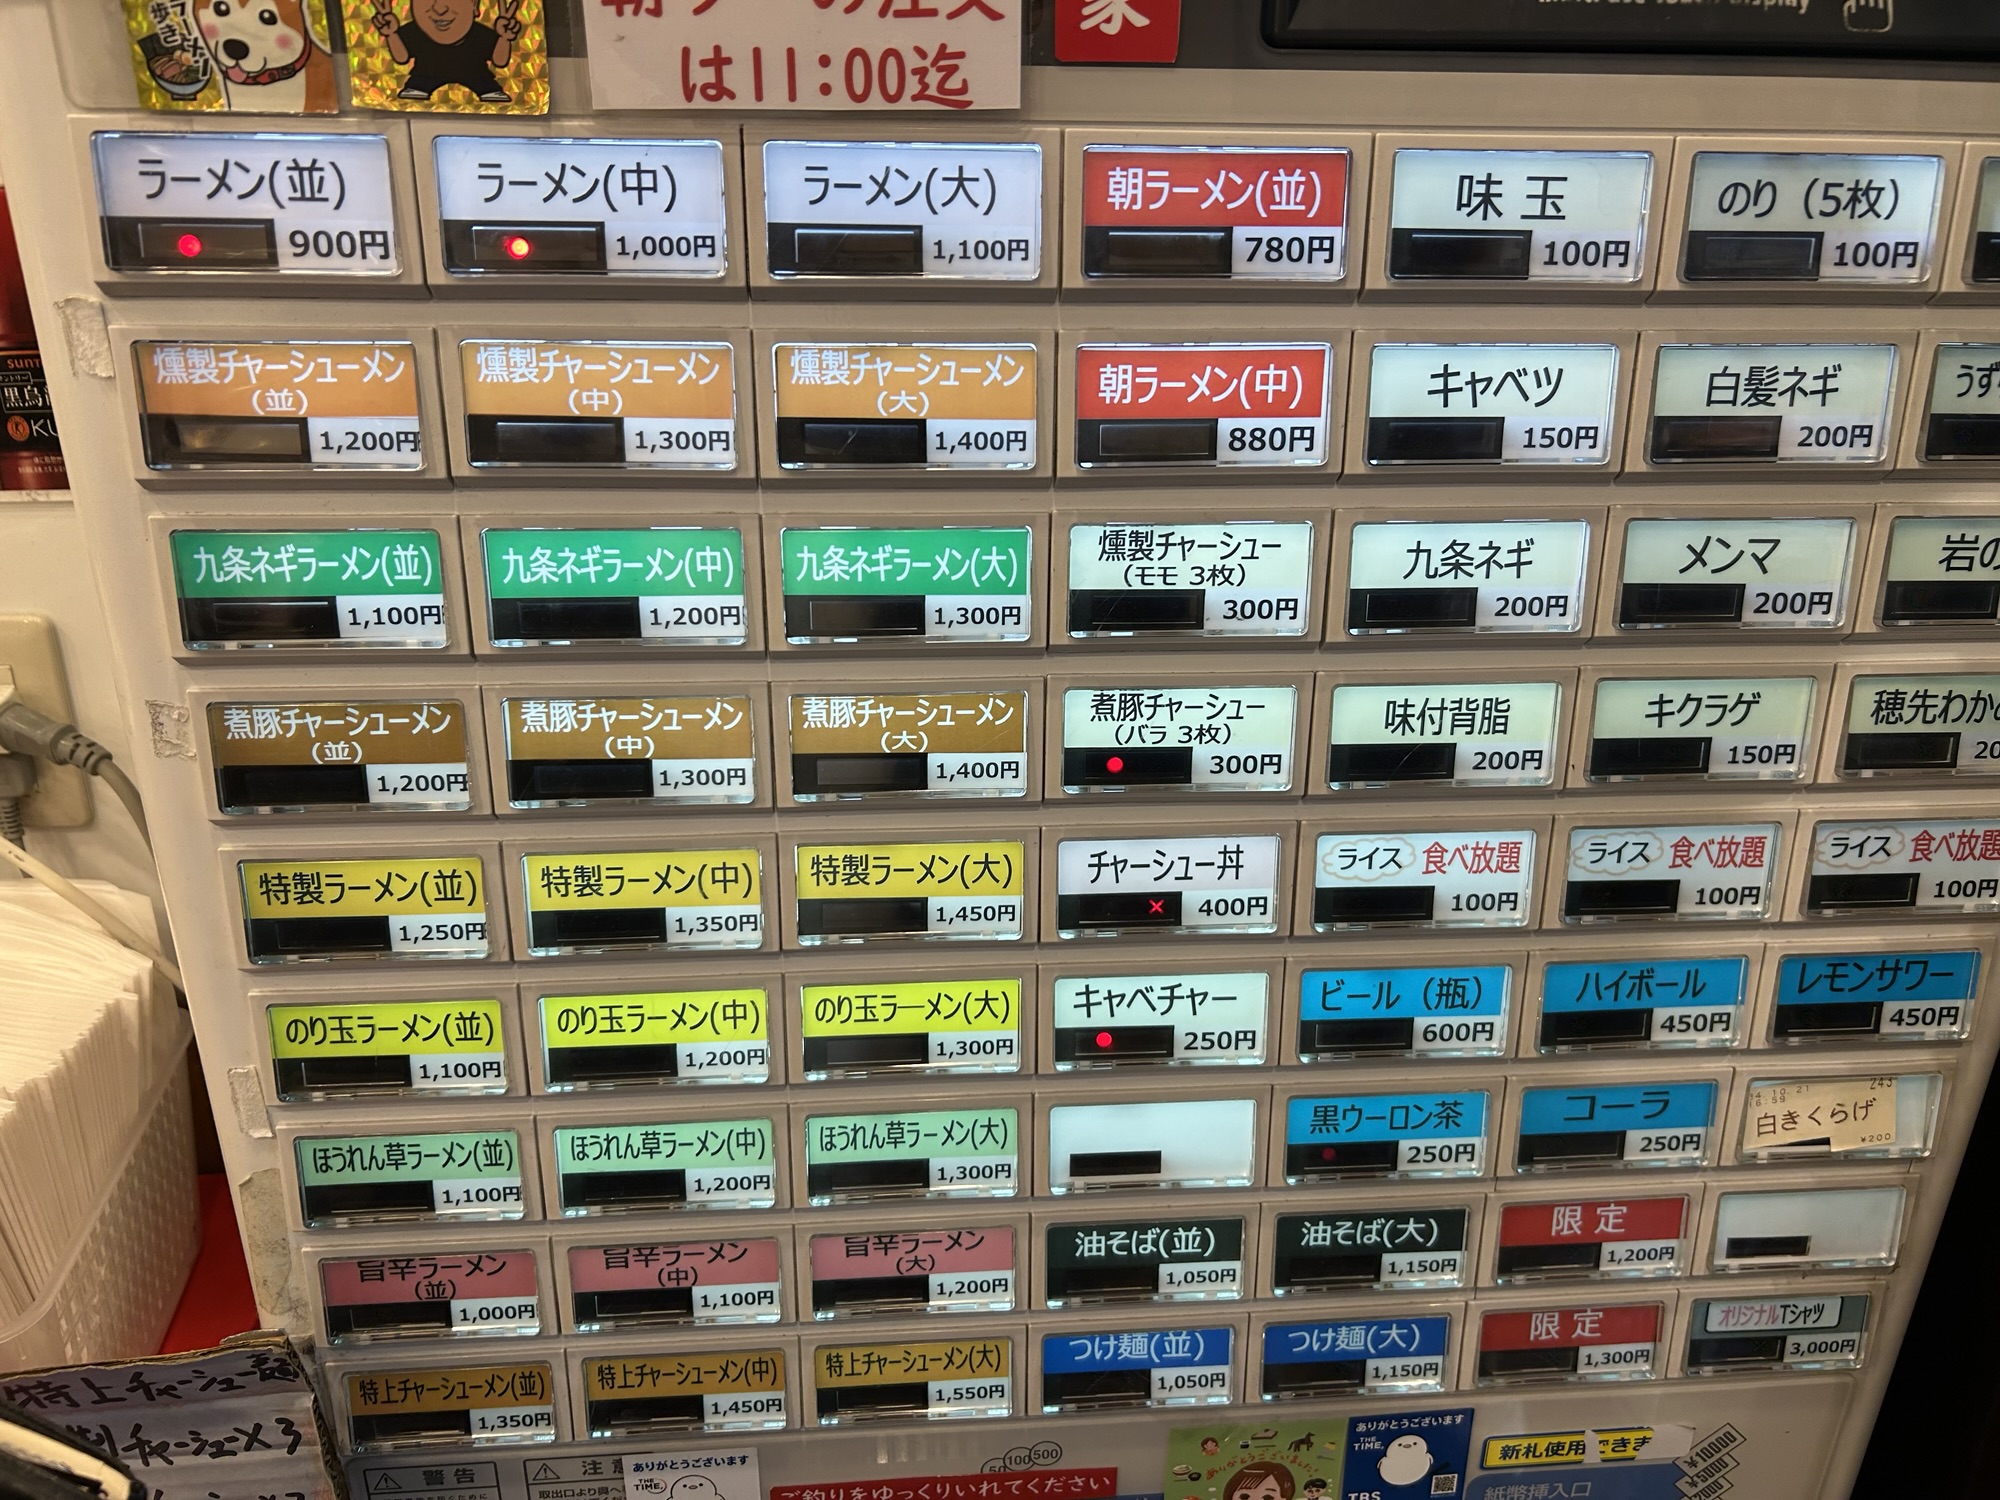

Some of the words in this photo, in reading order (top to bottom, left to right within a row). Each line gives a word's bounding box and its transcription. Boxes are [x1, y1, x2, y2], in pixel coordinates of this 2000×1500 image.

[680, 44, 973, 109] は11:00迄
[138, 158, 346, 209] ラーメン(並)
[478, 163, 677, 212] ラーメン(中)
[803, 165, 996, 214] ラーメン(大)
[1108, 167, 1322, 218] 朝ラーメン(並)
[289, 229, 390, 260] 900円
[616, 236, 716, 259] 1,000円
[933, 239, 1029, 262] 1,100円
[1245, 236, 1334, 263] 780円
[1543, 240, 1630, 268] 100円
[1833, 241, 1919, 268] 100円
[153, 346, 405, 385] 燻製チャーシューメン
[477, 345, 719, 385] 燻製チャーシューメン
[790, 347, 1024, 388] 燻製チャーシューメン
[1099, 363, 1302, 409] 朝ラーメン(中)
[1427, 363, 1564, 408] キャベツ
[1705, 364, 1843, 408] 白髪ネギ
[1957, 362, 2000, 398] うず
[252, 388, 308, 416] (並)
[569, 388, 622, 415] (中)
[877, 390, 929, 416] (大)
[320, 431, 420, 454] 1,200円
[634, 430, 730, 453] 1,300円
[934, 431, 1026, 453] 1,400円
[1228, 426, 1315, 452] 880円
[1522, 426, 1598, 450] 150円
[1798, 424, 1874, 449] 200円
[1098, 528, 1281, 563] 燻製チャーシュー
[1678, 535, 1781, 575] メンマ
[194, 544, 432, 587] 九条ネギラーメン(並)
[503, 544, 734, 587] 九条ネギラーメン(中)
[796, 545, 1017, 587] 九条ネギラーメン(大)
[1402, 538, 1534, 580] 九条ネギ
[1222, 598, 1299, 622] 300円
[1494, 595, 1568, 618] 200円
[1753, 591, 1833, 615] 200円
[348, 606, 442, 627] 1,100円
[650, 606, 740, 627] 1,200円
[934, 606, 1021, 627] 1,300円
[521, 700, 743, 734] 煮豚チャーシューメン
[802, 696, 1014, 730] 煮豚チャーシューメン
[1090, 692, 1265, 723] 煮豚チャーシュー
[1384, 697, 1511, 737] 味付背脂
[1644, 691, 1761, 729] キクラゲ
[1870, 688, 2000, 726] 穂先わか
[223, 703, 451, 740] 煮豚チャーシューメン
[311, 740, 362, 764] (並)
[605, 735, 654, 759] (中)
[881, 731, 928, 753] (大)
[1727, 743, 1796, 766] 150円
[936, 760, 1019, 782] 1,400円
[1209, 754, 1282, 777] 300円
[1472, 749, 1543, 772] 200円
[377, 773, 467, 795] 1,200円
[659, 768, 746, 788] 1,300円
[1337, 846, 1403, 873] ライス
[1422, 840, 1523, 876] 食べ放題
[1588, 840, 1651, 866] ライス
[1669, 834, 1767, 870] 食べ放題
[1830, 834, 1891, 859] ライス
[1909, 829, 2000, 863] 食べ放題
[811, 852, 1013, 890] 特製ラーメン(大)
[1087, 844, 1245, 884] チャーシュー丼
[258, 868, 478, 908] 特製ラーメン(並)
[541, 861, 753, 900] 特製ラーメン(中)
[1933, 878, 1998, 899] 100円
[1198, 896, 1268, 917] 400円
[1451, 891, 1519, 913] 100円
[1695, 884, 1760, 906] 100円
[674, 913, 758, 935] 1,350円
[935, 904, 1016, 924] 1,450円
[399, 921, 486, 944] 1,250円
[1576, 967, 1706, 1003] ハイボール
[1797, 959, 1954, 994] レモンサワー
[815, 989, 1010, 1025] のり玉ラーメン(大)
[1073, 982, 1237, 1019] キャベチャー
[286, 1010, 494, 1047] のり玉ラーメン(並)
[557, 998, 760, 1035] のり玉ラーメン(中)
[1661, 1012, 1731, 1034] 450円
[1889, 1006, 1959, 1027] 450円
[1183, 1030, 1256, 1051] 250円
[1422, 1021, 1494, 1043] 600円
[685, 1048, 765, 1068] 1,200円
[936, 1038, 1014, 1058] 1,300円
[419, 1061, 500, 1081] 1,100円
[1310, 1101, 1464, 1135] 黒ウーロン茶
[1563, 1090, 1672, 1122] コーラ
[1757, 1097, 1877, 1137] 白きくらげ
[571, 1127, 765, 1162] ほうれん草ラーメン(中)
[819, 1117, 1008, 1152] ほうれん草ラーメン(大)
[1640, 1132, 1700, 1153] 250円
[1861, 1132, 1891, 1143] ¥200
[313, 1139, 514, 1174] ほうれん草ラーメン(並)
[1407, 1142, 1475, 1163] 250円
[693, 1174, 770, 1193] 1,200円
[937, 1164, 1011, 1183] 1,300円
[442, 1185, 520, 1205] 1,100円
[1074, 1226, 1215, 1259] 油そば(並)
[1300, 1215, 1438, 1248] 油そば(大)
[896, 1254, 935, 1275] (大)
[1387, 1257, 1457, 1276] 1,150円
[1606, 1245, 1675, 1264] 1,200円
[657, 1267, 698, 1288] (中)
[936, 1278, 1008, 1297] 1,200円
[1165, 1268, 1236, 1287] 1,050円
[414, 1280, 457, 1301] (並)
[700, 1290, 774, 1309] 1,100円
[459, 1303, 535, 1322] 1,000円
[1718, 1302, 1825, 1328] オリジナルTシャツ
[1069, 1330, 1205, 1361] つけ麺(並)
[1287, 1324, 1420, 1354] つけ麺(大)
[1790, 1339, 1856, 1357] 3,000円
[826, 1345, 1001, 1379] 特上チャーシューメン(大)
[1371, 1361, 1439, 1380] 1,150円
[1583, 1349, 1650, 1368] 1,300円
[598, 1358, 777, 1391] 特上チャーシューメン(中)
[1157, 1372, 1226, 1391] 1,050円
[359, 1370, 546, 1406] 特上チャーシューメン(並)
[935, 1384, 1005, 1401] 1,550円
[710, 1398, 782, 1416] 1,450円
[478, 1412, 551, 1430] 1,350円
[1356, 1414, 1464, 1432] ありがとうございます
[1007, 1455, 1030, 1465] 100
[1034, 1449, 1058, 1459] 500
[1683, 1431, 1737, 1468] ¥10000
[633, 1455, 749, 1472] ありがとうございます
